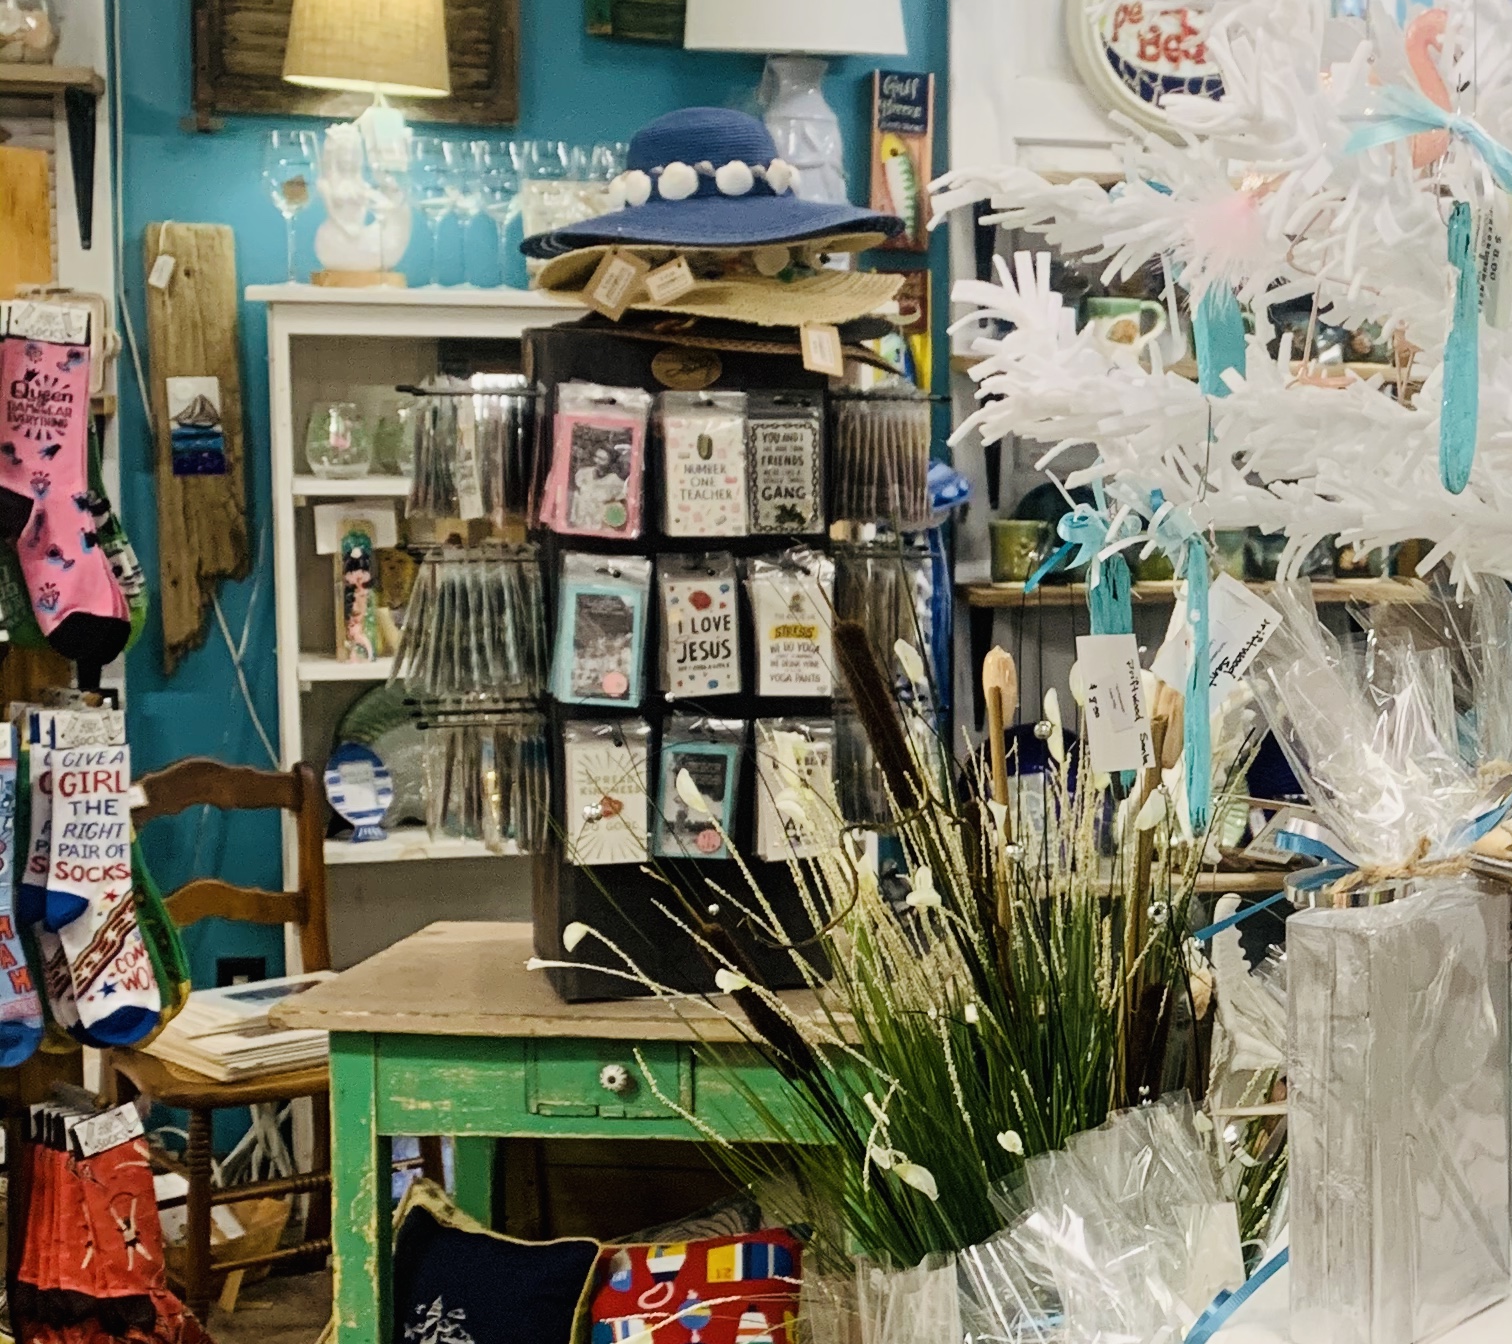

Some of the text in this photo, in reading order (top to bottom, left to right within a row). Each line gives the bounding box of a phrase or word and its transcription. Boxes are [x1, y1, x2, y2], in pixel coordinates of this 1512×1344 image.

[10, 380, 73, 403] Queen
[684, 464, 726, 475] NUMBER
[762, 456, 804, 466] FRIENDS
[690, 477, 716, 487] ONE
[680, 489, 732, 501] TEACHER
[762, 486, 806, 501] GANG
[691, 614, 731, 635] LOVE
[775, 624, 816, 639] STRESS
[677, 639, 732, 664] JESUS
[62, 750, 124, 767] GIVE A
[59, 770, 128, 797] GIRL
[69, 799, 118, 816] THE
[63, 822, 125, 840] RIGHT
[59, 842, 128, 859] PAIR OF
[56, 861, 130, 883] SOCKS
